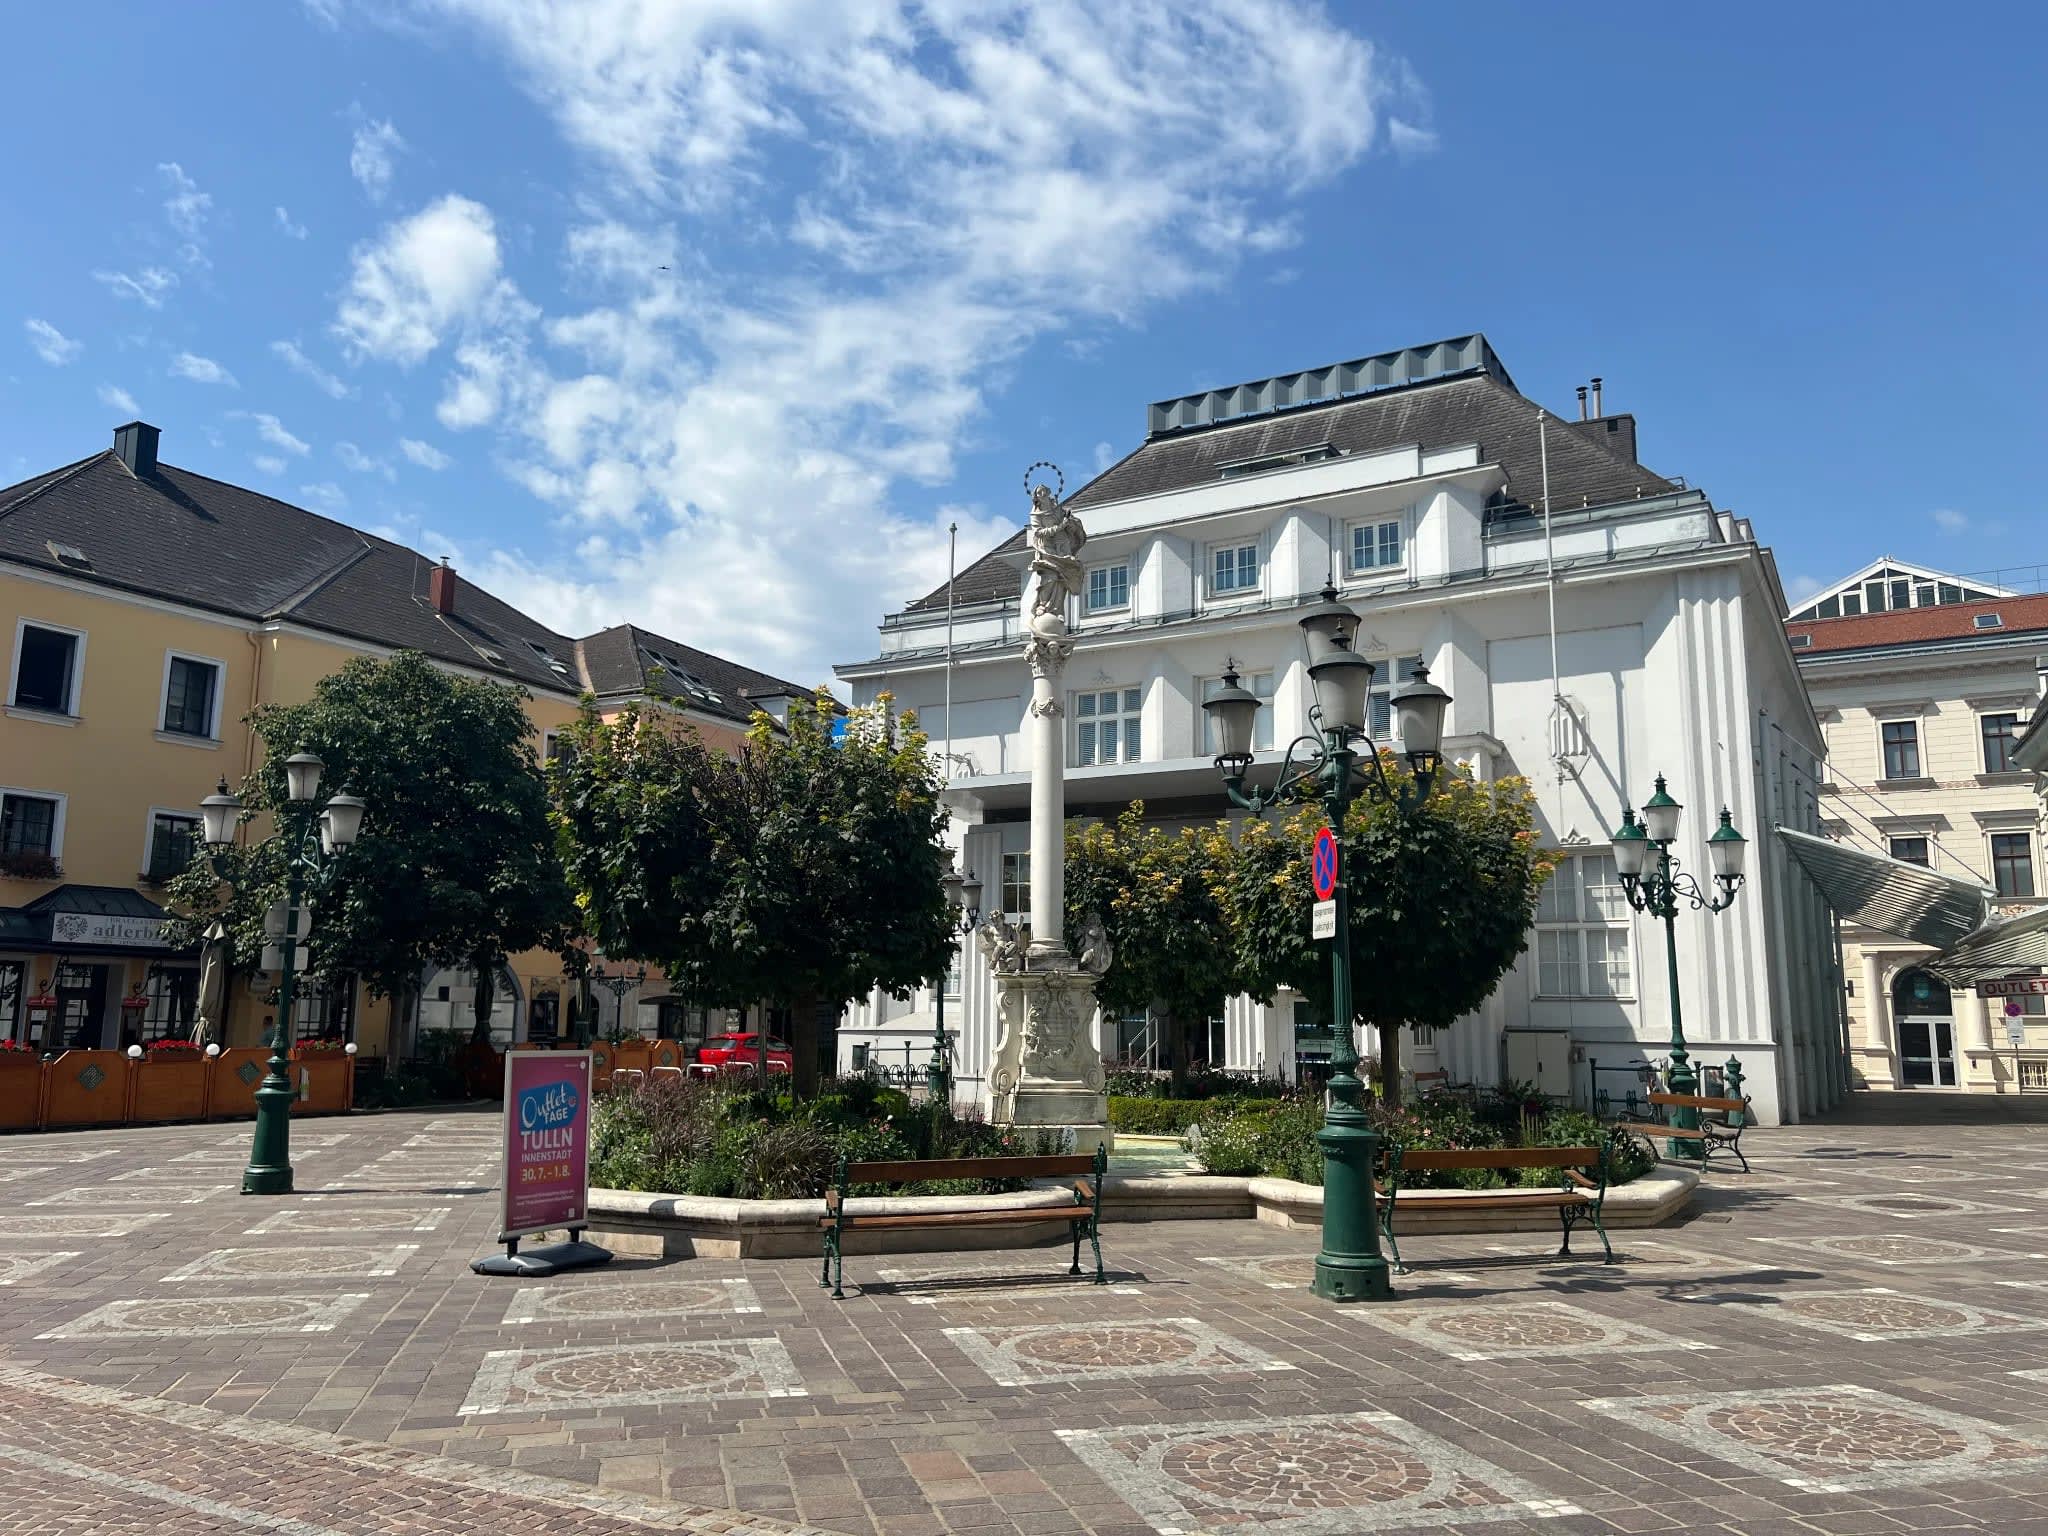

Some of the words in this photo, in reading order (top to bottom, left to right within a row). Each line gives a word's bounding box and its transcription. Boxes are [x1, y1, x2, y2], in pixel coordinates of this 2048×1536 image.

[1985, 981, 2048, 994] OUTLET
[521, 1082, 569, 1129] Outlet
[544, 1108, 569, 1124] TAGE
[520, 1127, 573, 1151] TULLN
[521, 1150, 572, 1162] INNENSTADT
